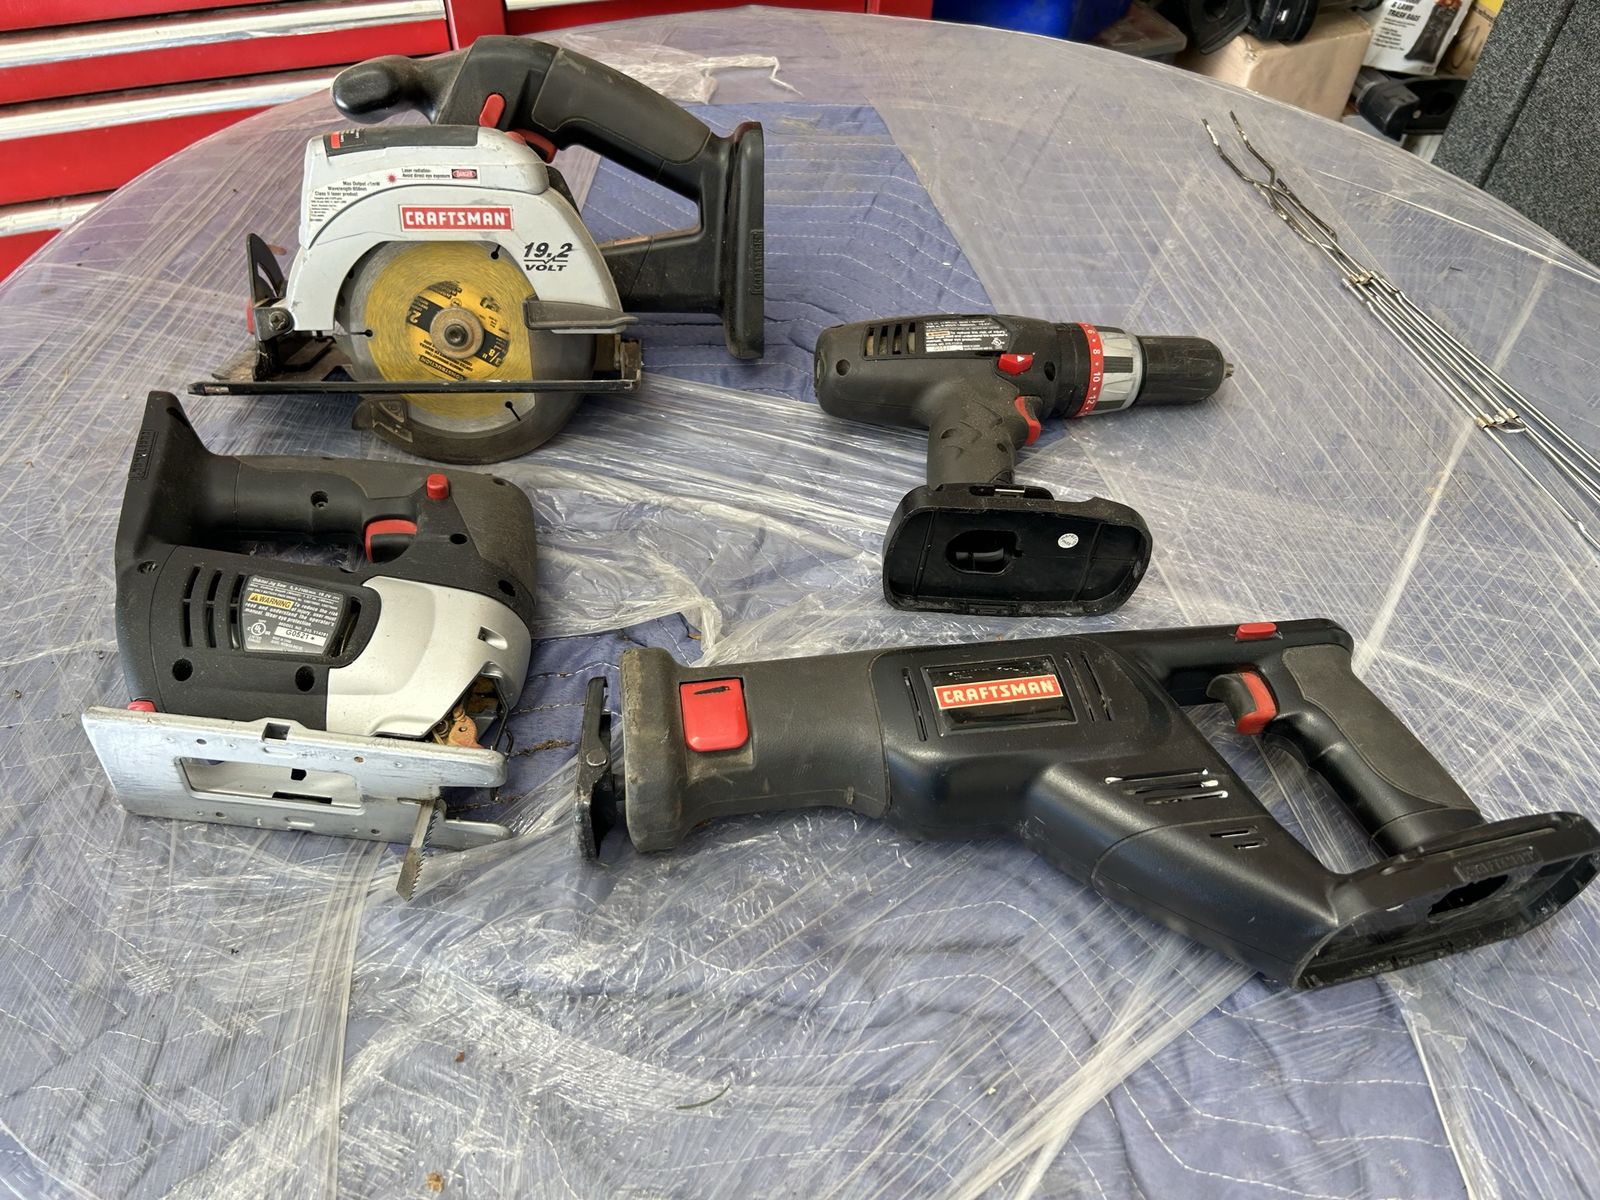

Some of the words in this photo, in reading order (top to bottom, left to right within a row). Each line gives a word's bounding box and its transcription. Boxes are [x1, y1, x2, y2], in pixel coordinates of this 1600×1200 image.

[1396, 2, 1415, 12] LAWN
[1387, 9, 1406, 19] TRASH
[405, 212, 505, 226] CRAFTSMAN
[524, 242, 572, 258] 19.2
[419, 356, 464, 380] CONSTRUCTION
[1093, 372, 1100, 382] 10
[1087, 396, 1096, 404] 12
[259, 595, 292, 608] WARNING
[270, 607, 298, 618] understand
[310, 616, 335, 626] operator's
[285, 629, 309, 640] G0521
[942, 680, 1054, 704] CRAFTSMAN
